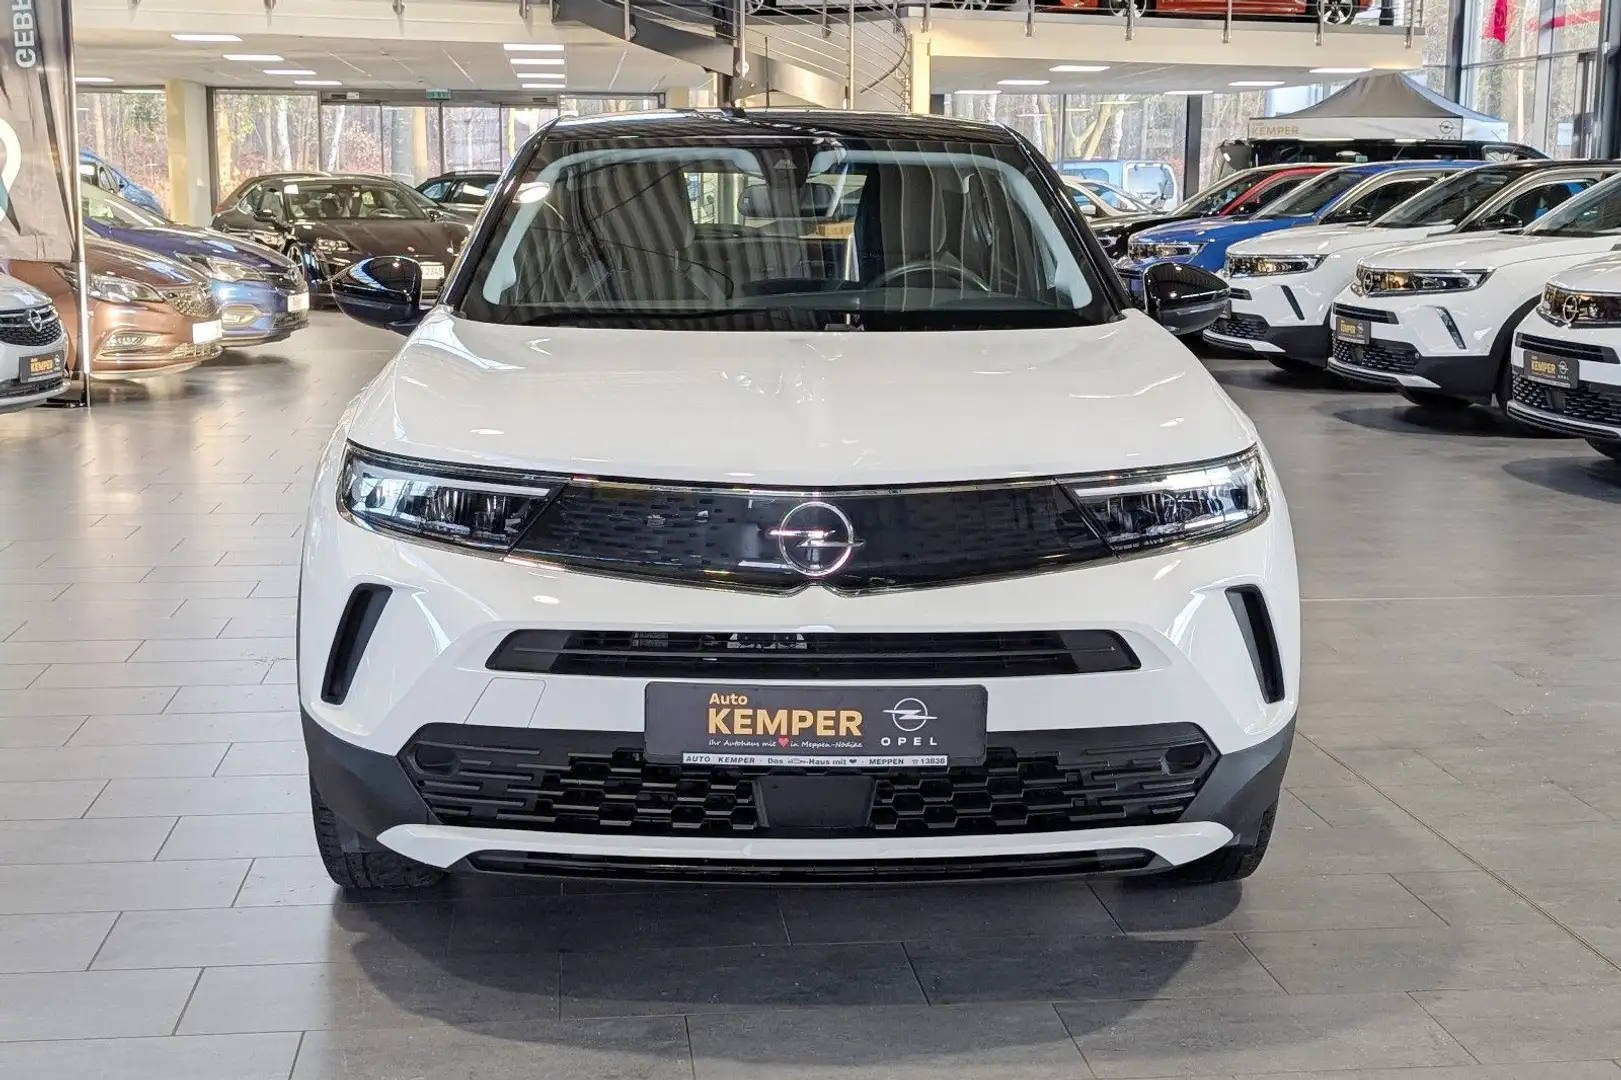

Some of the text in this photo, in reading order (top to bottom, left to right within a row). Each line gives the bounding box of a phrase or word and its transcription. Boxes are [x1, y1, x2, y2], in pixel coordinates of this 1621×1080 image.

[709, 692, 748, 705] Auto
[708, 707, 863, 737] KEMPER
[708, 738, 721, 746] Ihr
[723, 738, 760, 747] Autohaus
[762, 739, 776, 747] mit
[790, 739, 799, 747] in
[880, 736, 938, 746] OPEL
[685, 755, 711, 763] AUTO
[718, 756, 756, 764] KEMPER
[767, 757, 784, 765] Das
[869, 757, 905, 765] MEPPEN
